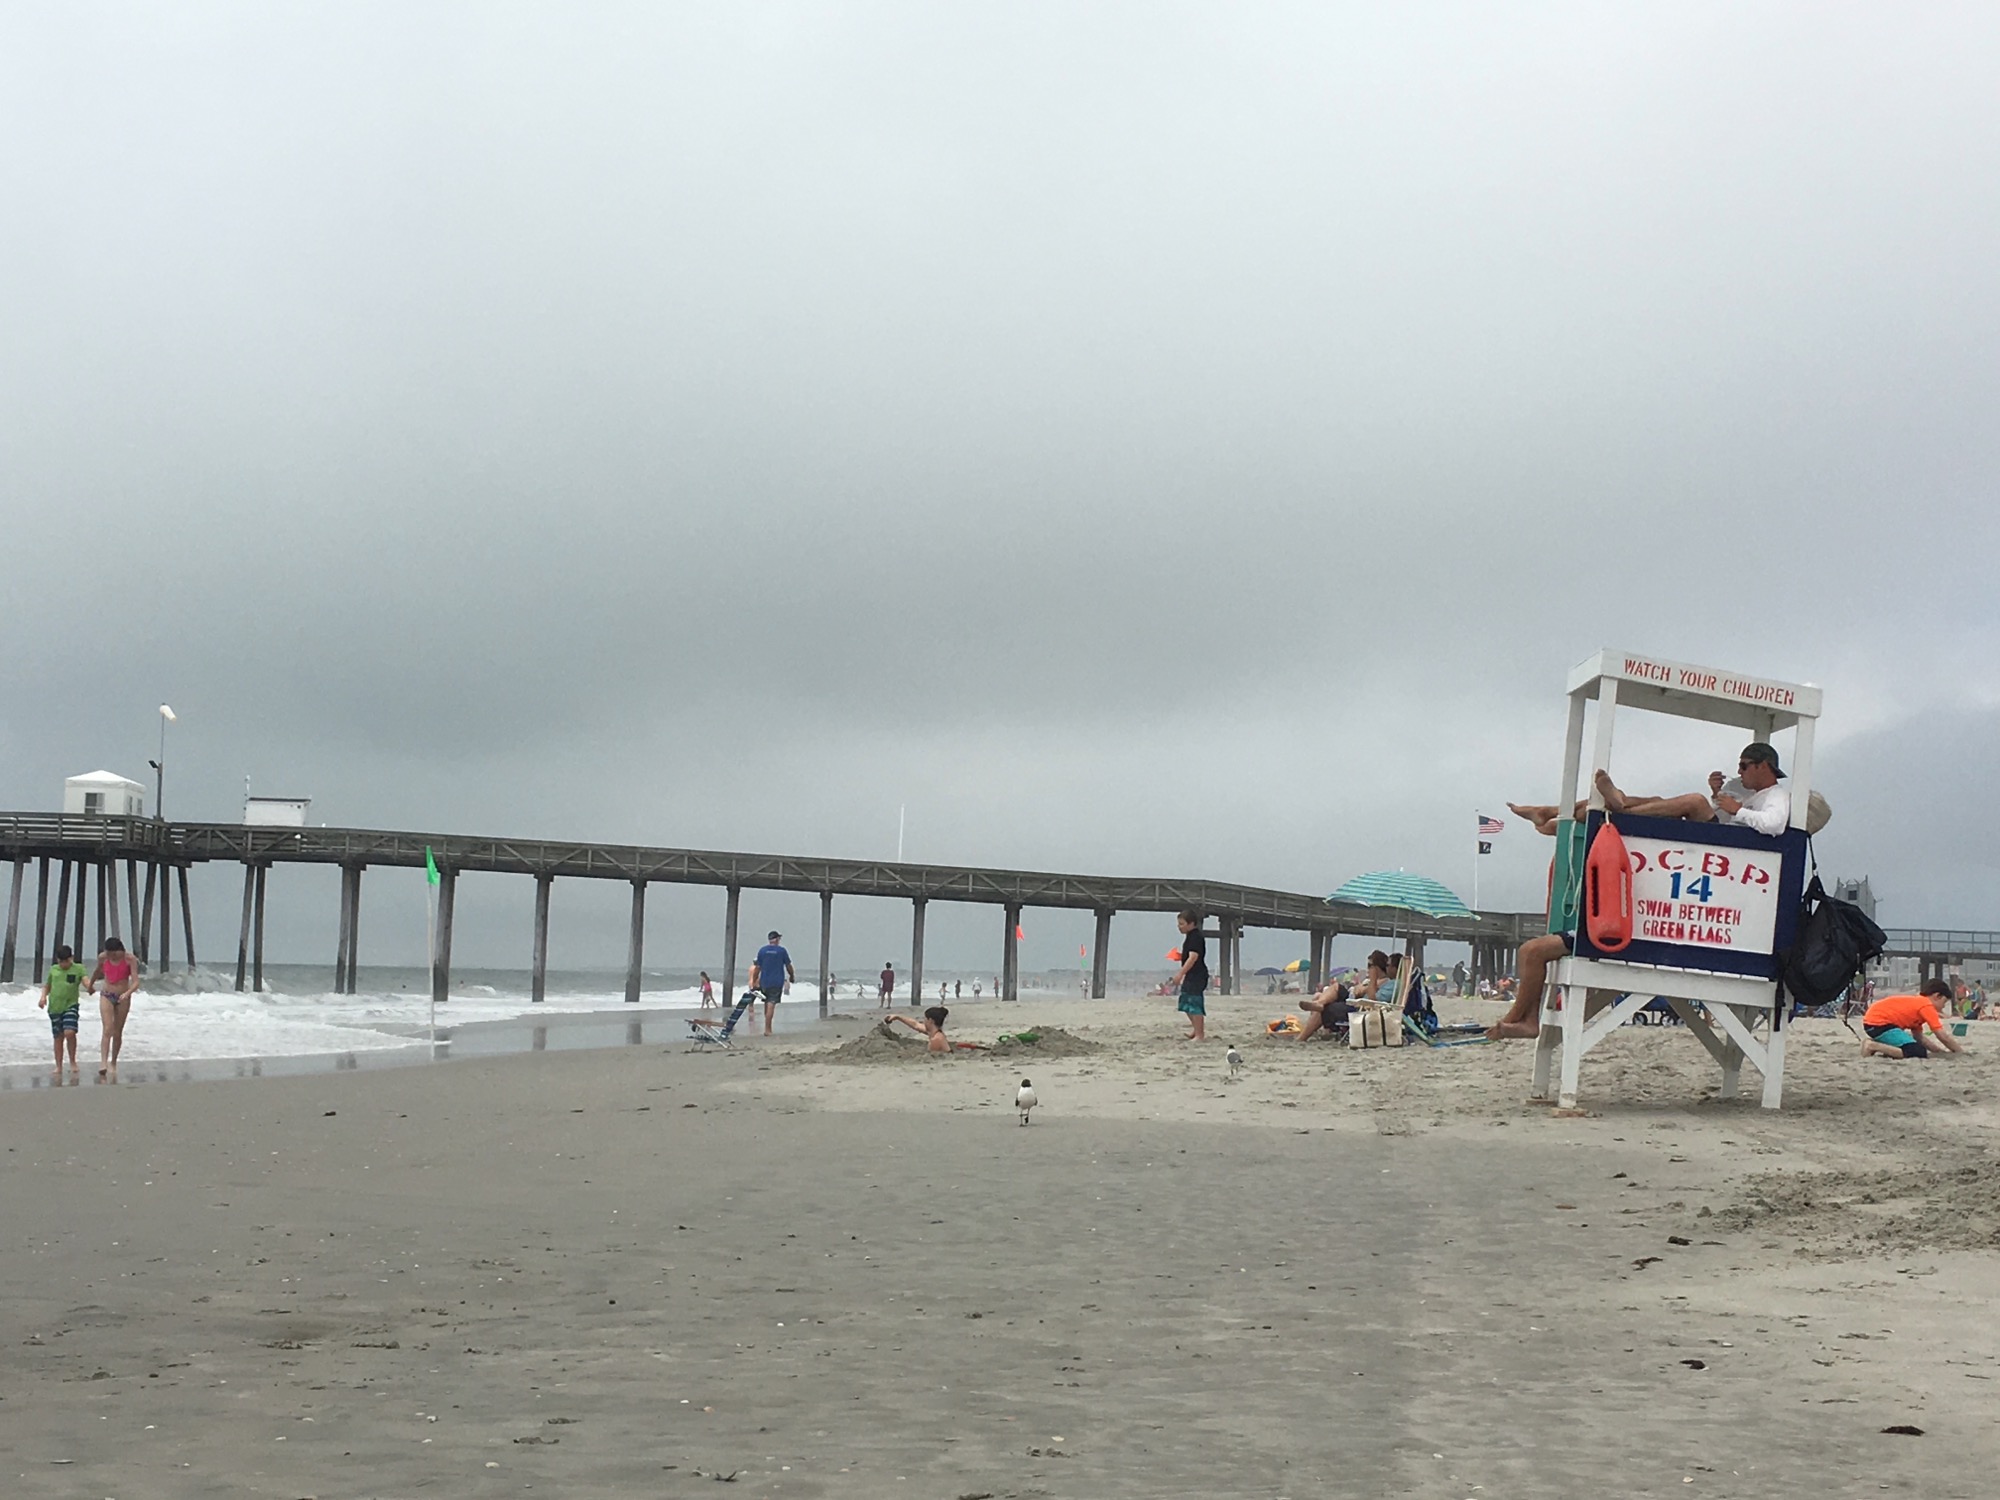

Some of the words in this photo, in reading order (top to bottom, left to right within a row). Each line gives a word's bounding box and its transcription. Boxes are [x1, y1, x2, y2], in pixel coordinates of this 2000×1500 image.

[1624, 658, 1671, 682] WATCH
[1679, 669, 1717, 691] YOUR
[1723, 679, 1795, 706] CHILDREN
[1670, 872, 1713, 902] 14
[1637, 900, 1672, 918] SWIM
[1679, 904, 1742, 926] BETWEEN
[1643, 919, 1684, 939] GREEN
[1689, 924, 1732, 944] FLAGS
